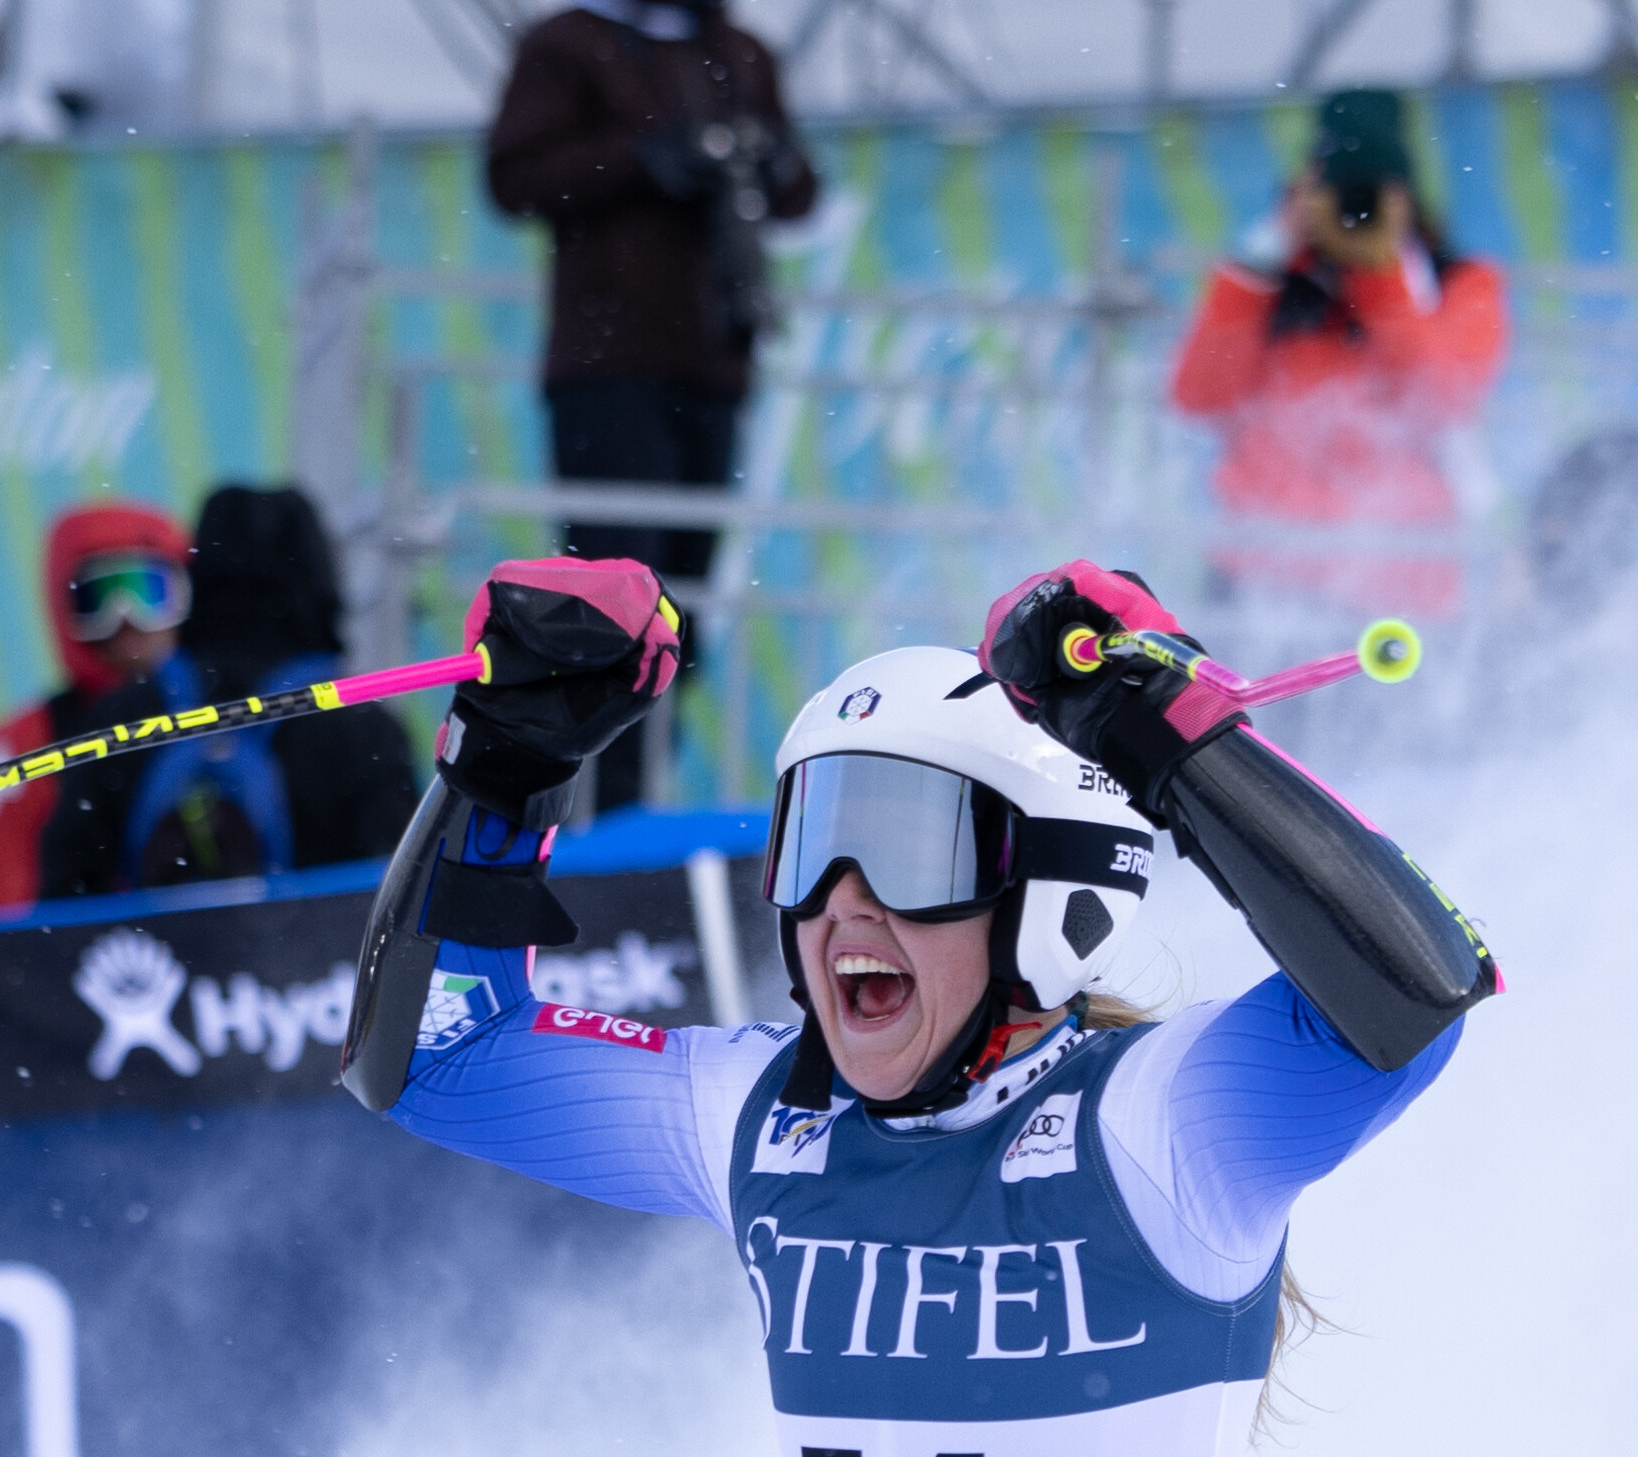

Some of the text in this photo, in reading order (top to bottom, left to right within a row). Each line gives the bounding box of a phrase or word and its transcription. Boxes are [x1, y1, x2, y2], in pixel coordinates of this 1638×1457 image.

[190, 932, 685, 1070] Hyd ask
[553, 1007, 653, 1044] enel
[746, 1216, 1146, 1359] STIFEL
